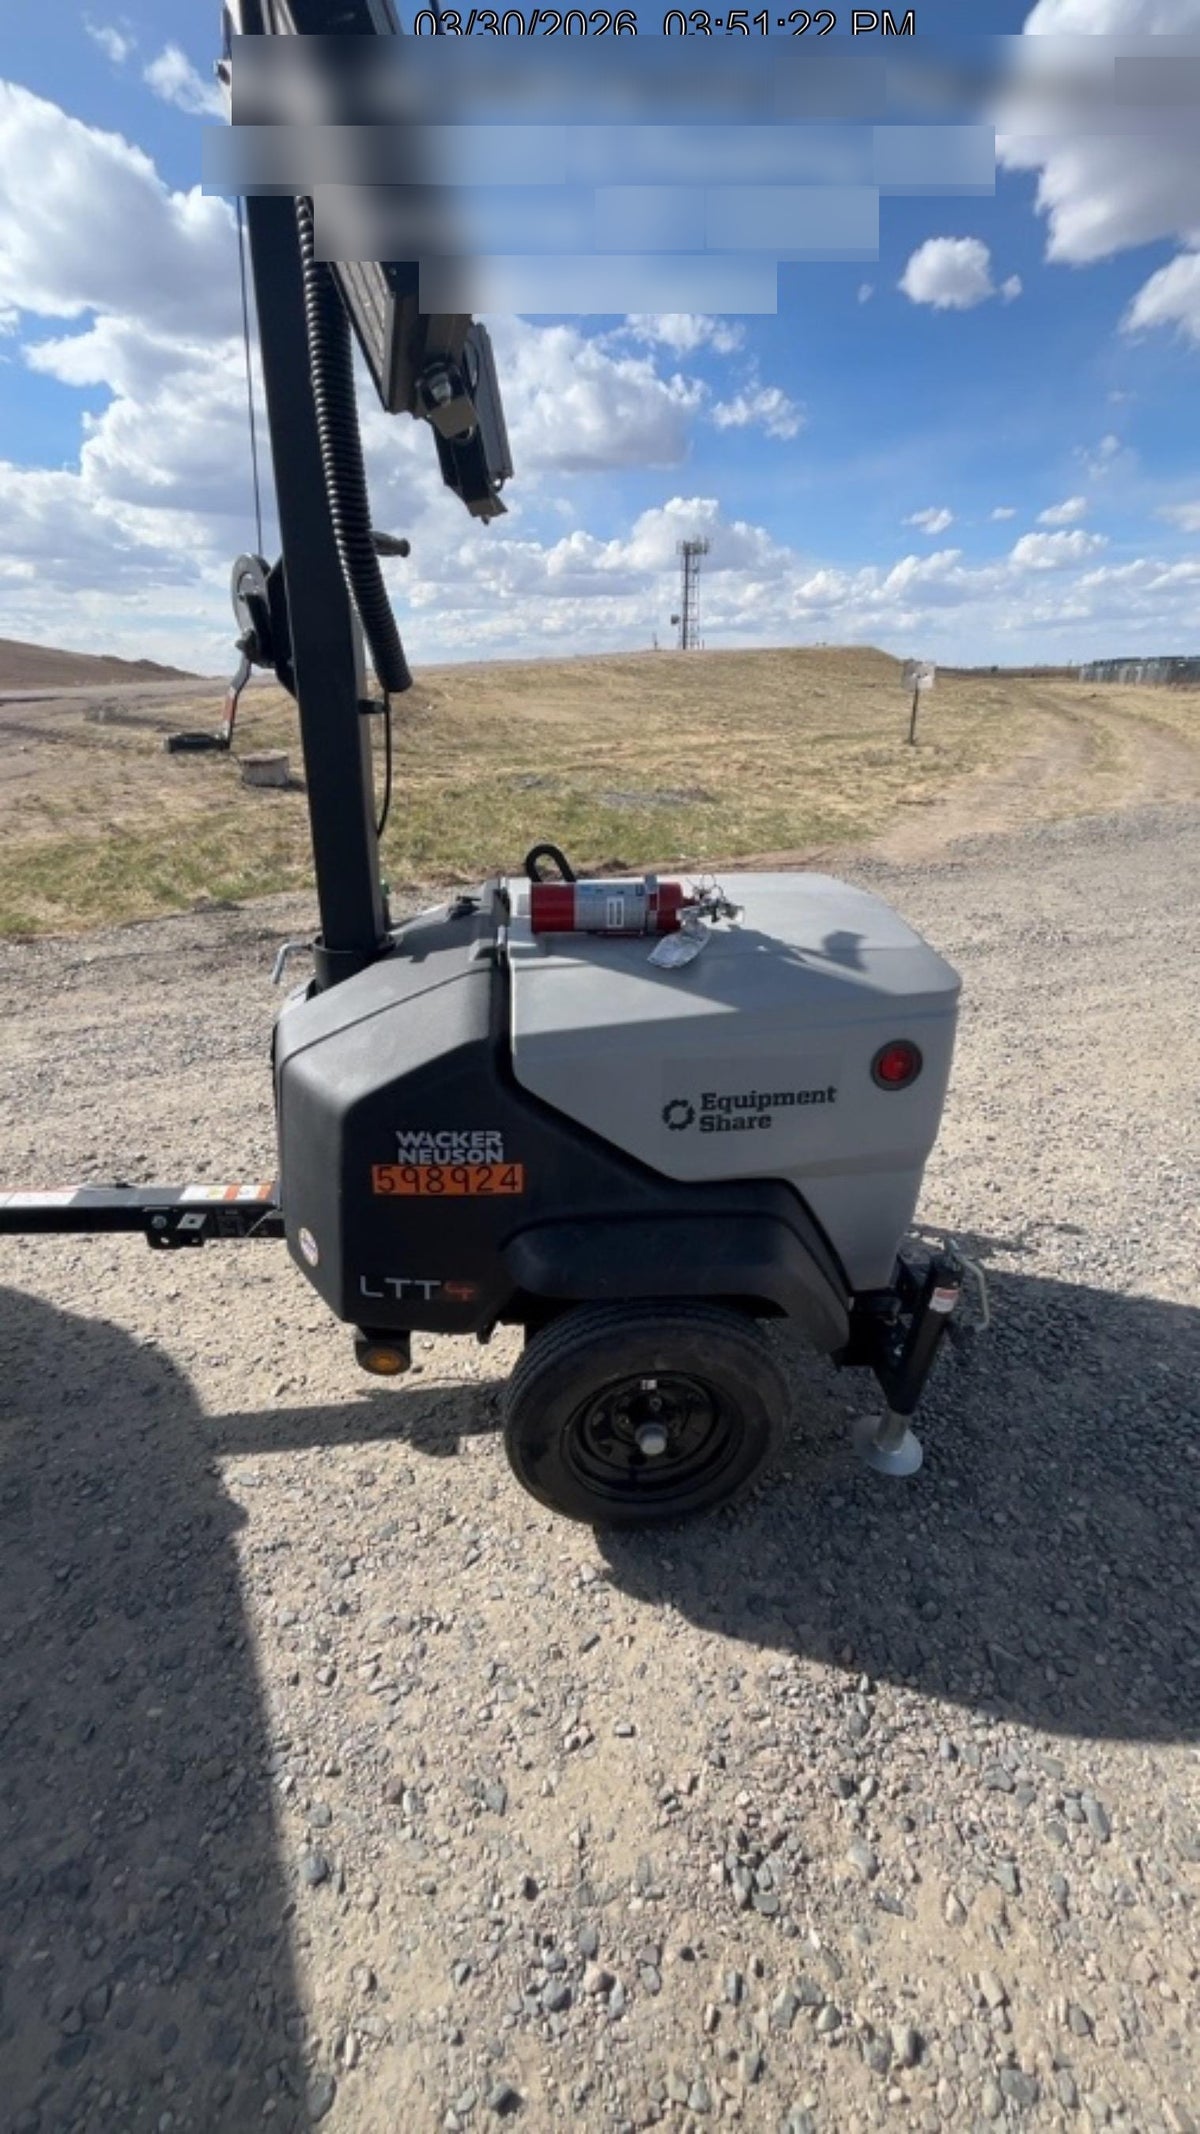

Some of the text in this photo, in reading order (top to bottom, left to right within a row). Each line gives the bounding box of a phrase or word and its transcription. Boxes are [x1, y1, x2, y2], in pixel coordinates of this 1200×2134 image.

[701, 1086, 837, 1114] Equipment
[699, 1114, 772, 1133] Share
[396, 1130, 504, 1149] WACKER
[398, 1149, 504, 1165] NEUSON
[375, 1166, 519, 1194] 598924
